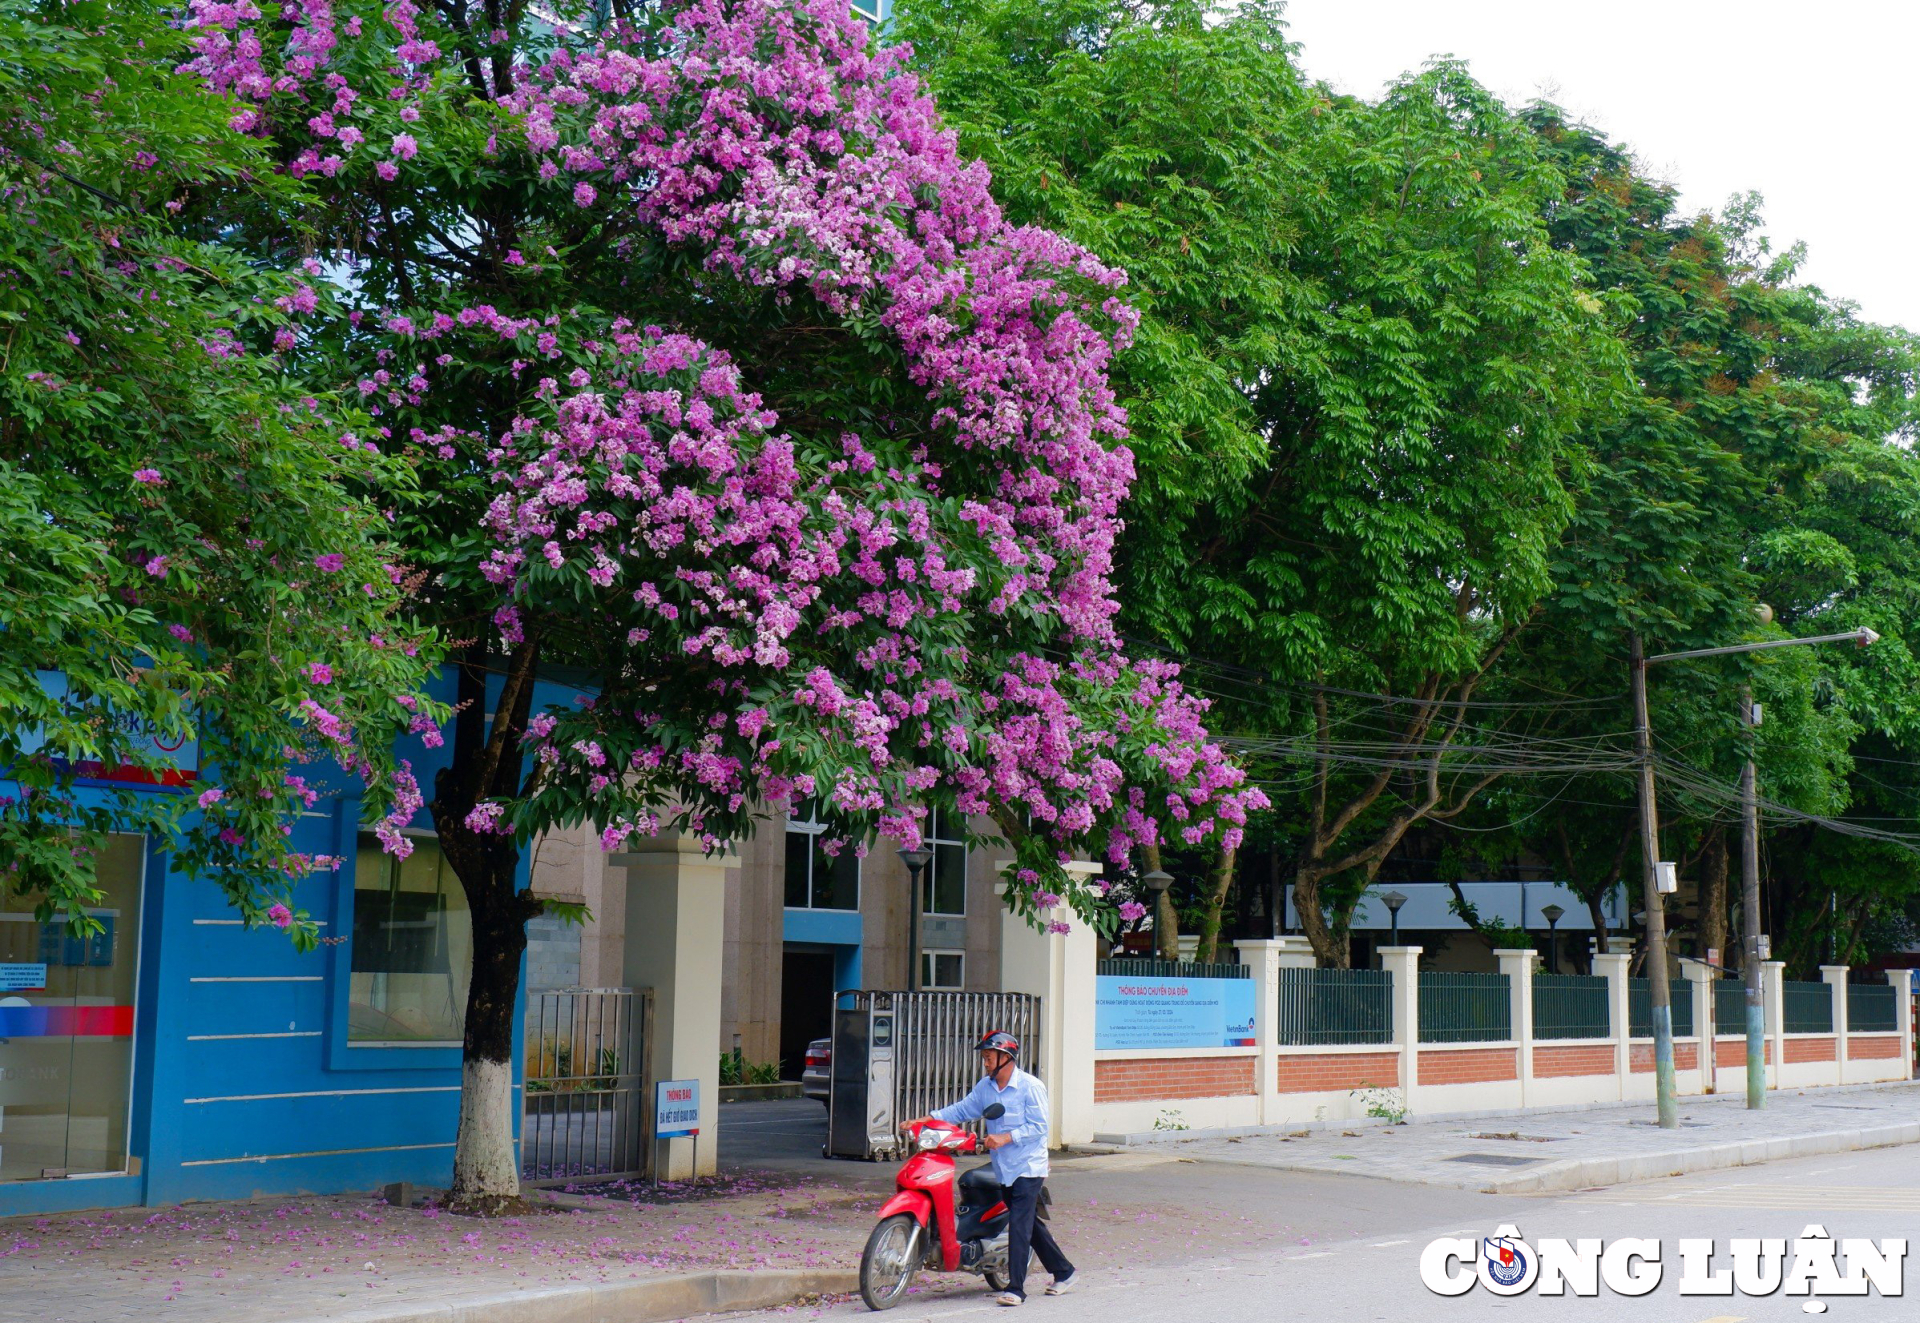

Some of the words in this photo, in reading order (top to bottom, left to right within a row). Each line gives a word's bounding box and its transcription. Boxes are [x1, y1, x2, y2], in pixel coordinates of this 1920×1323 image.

[1118, 984, 1136, 996] THÔNG
[1136, 984, 1147, 996] BÁO
[1148, 984, 1167, 996] CHUYỂN
[1226, 1024, 1249, 1033] VietinBank
[666, 1088, 682, 1101] THÔNG
